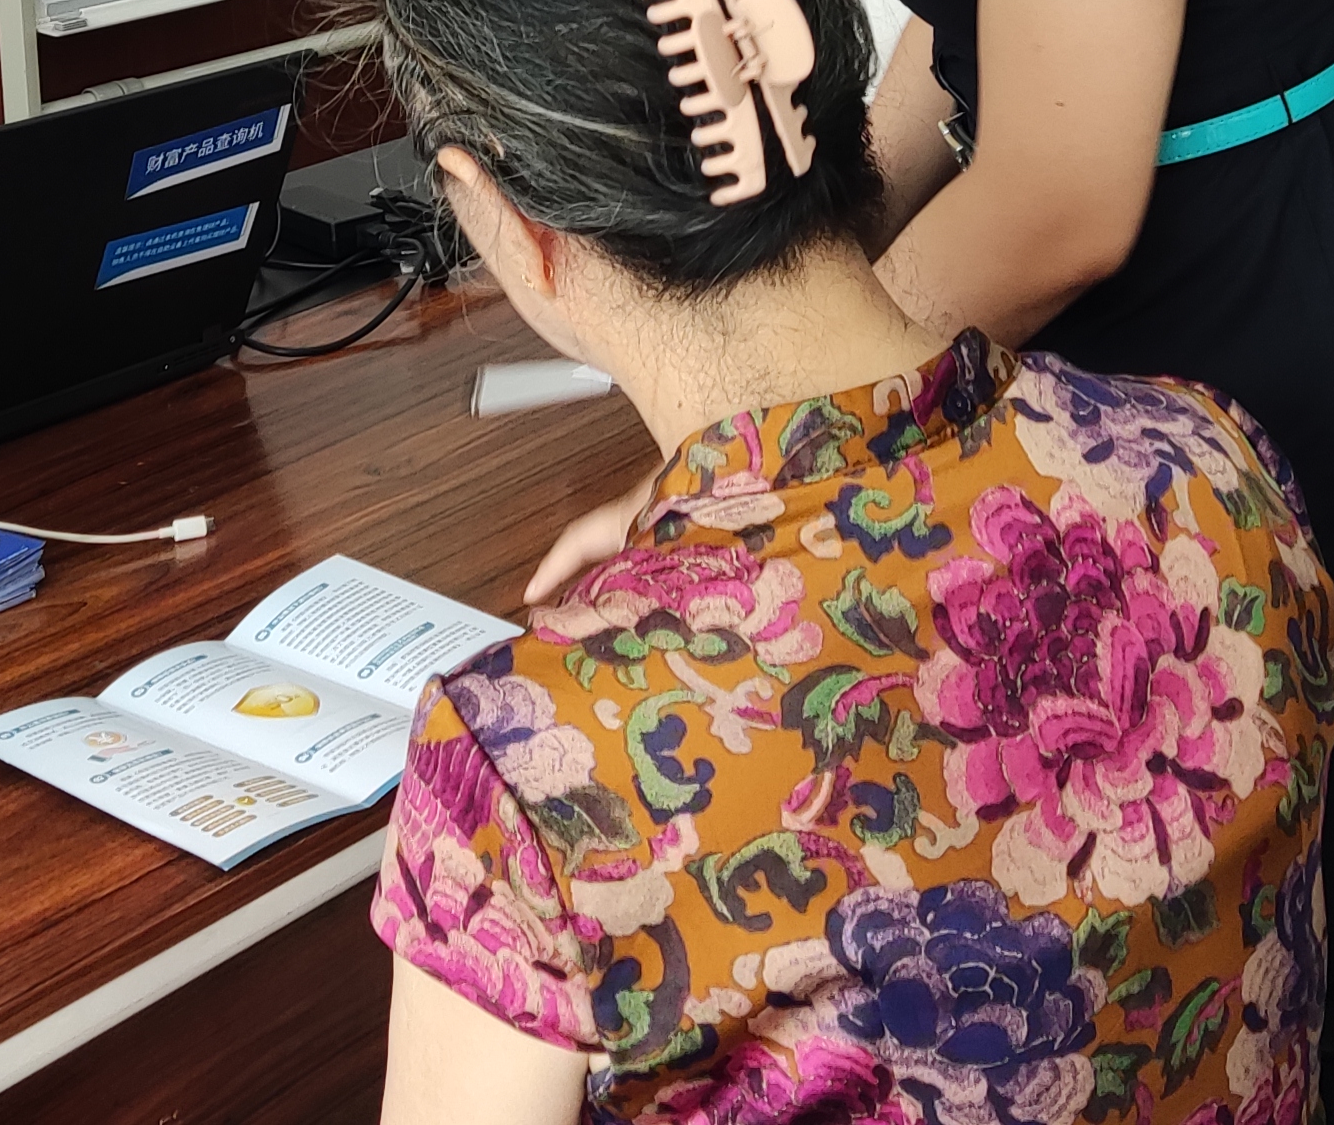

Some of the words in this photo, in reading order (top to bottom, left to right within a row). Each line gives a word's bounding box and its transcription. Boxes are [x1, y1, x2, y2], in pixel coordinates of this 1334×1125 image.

[145, 121, 265, 176] 财富产品查询机
